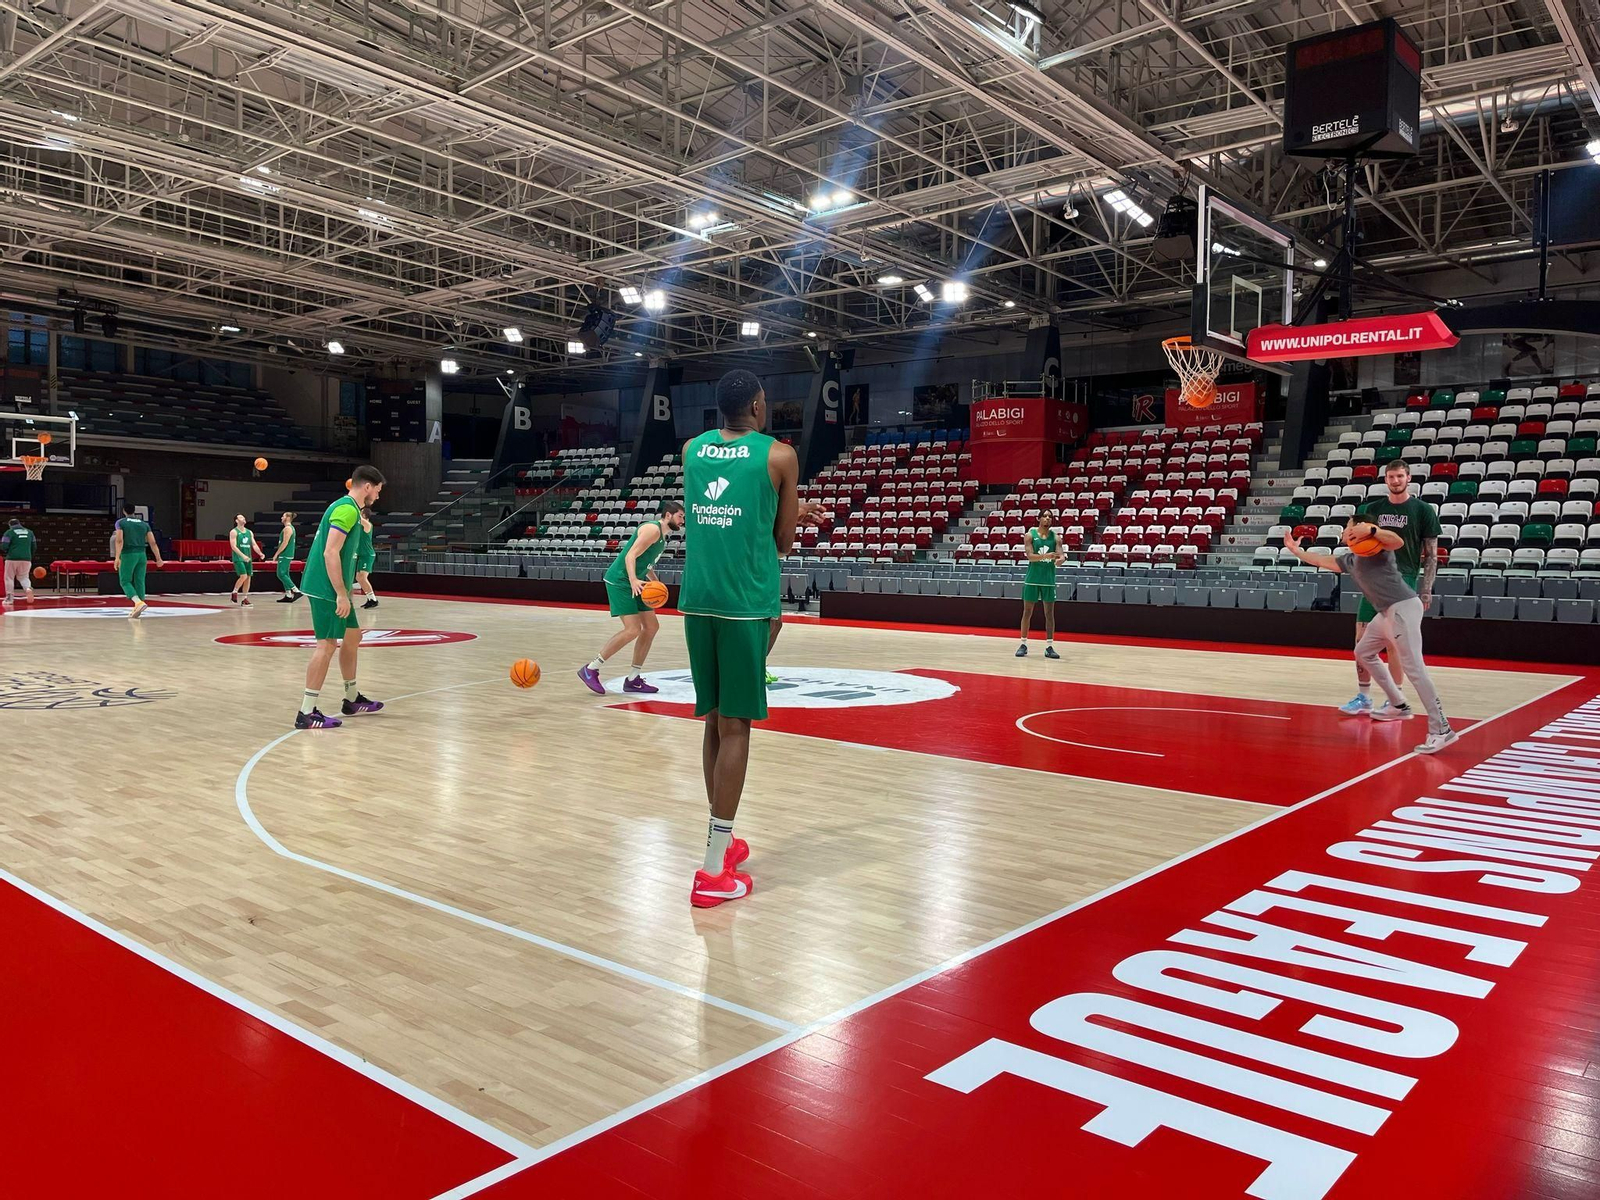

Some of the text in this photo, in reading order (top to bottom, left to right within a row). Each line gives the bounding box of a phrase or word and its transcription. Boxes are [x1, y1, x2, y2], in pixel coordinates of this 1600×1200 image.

[1260, 327, 1423, 351] WWW.UNIPOLRENTAL.IT
[822, 380, 839, 408] C
[514, 406, 532, 431] B
[653, 394, 671, 421] B
[976, 407, 1024, 422] PALABIGI
[428, 420, 442, 443] A
[692, 503, 742, 516] Fundación
[697, 514, 733, 529] Unicaja
[923, 869, 1550, 1200] LEAGUE
